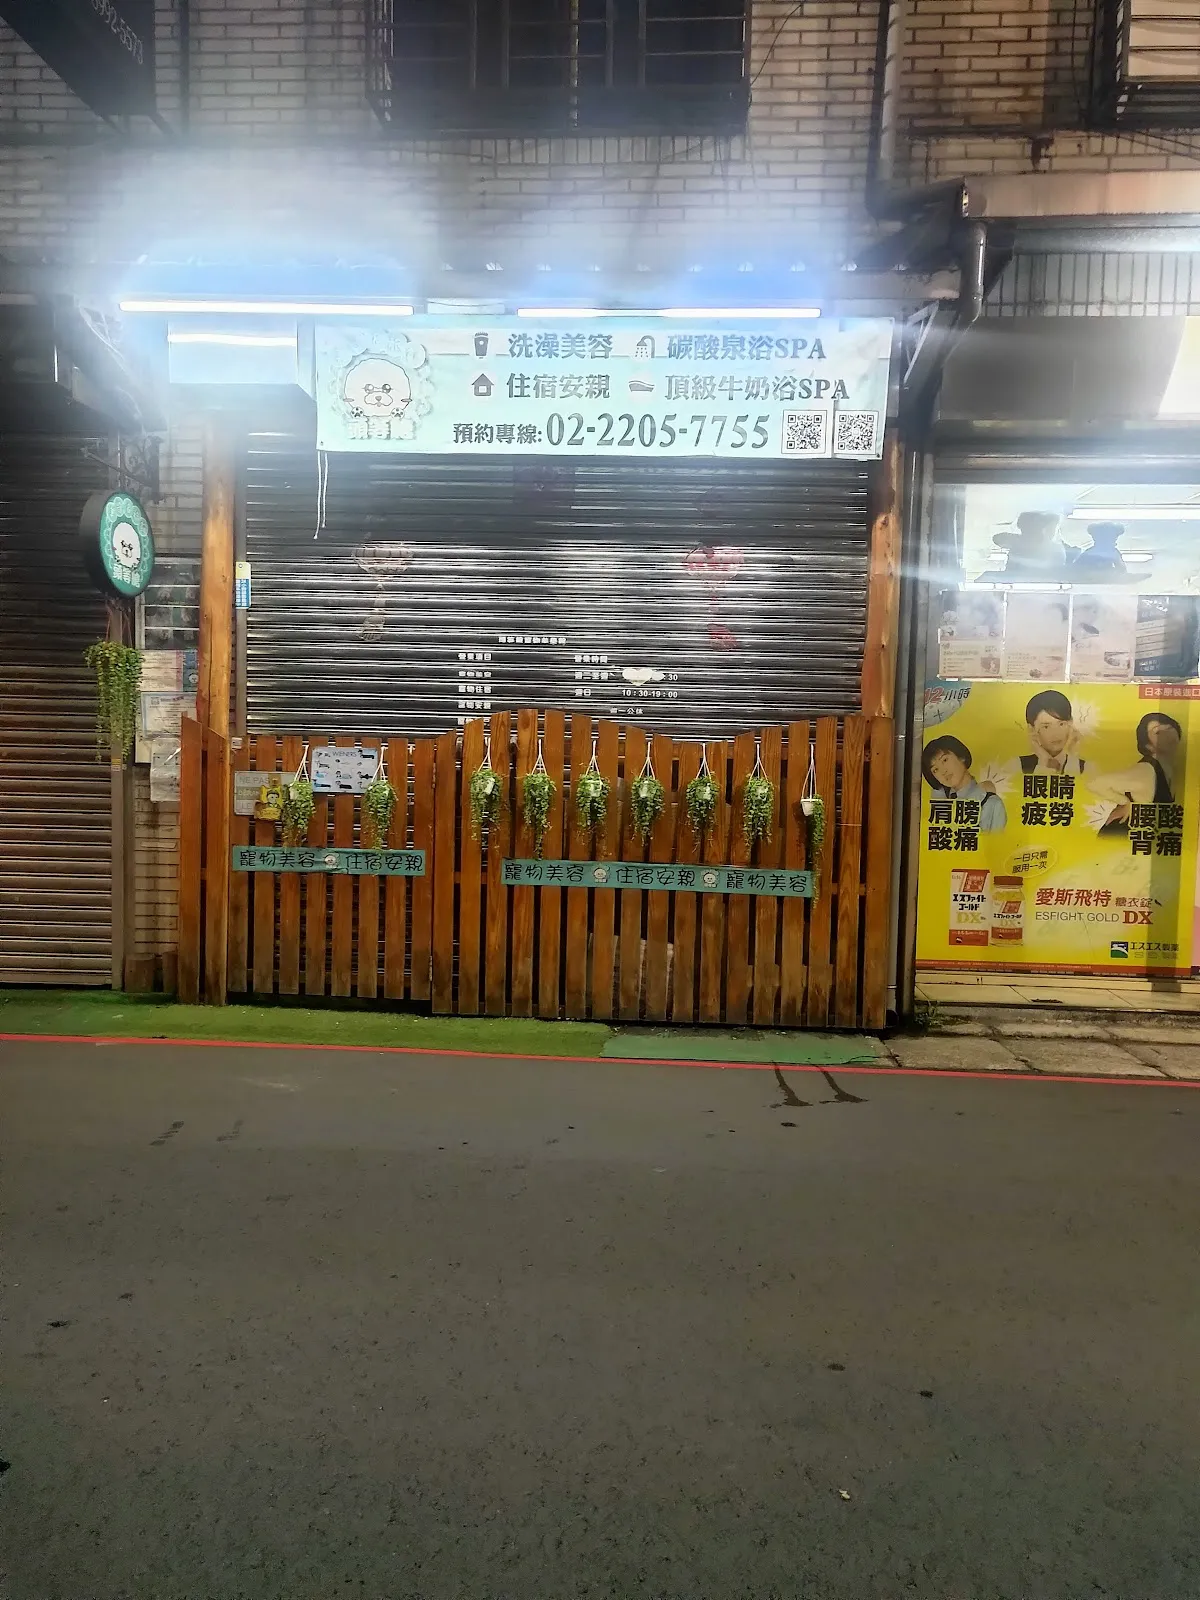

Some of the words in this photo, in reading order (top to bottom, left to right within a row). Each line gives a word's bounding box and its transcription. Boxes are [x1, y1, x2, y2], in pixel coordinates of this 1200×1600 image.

[508, 333, 613, 359] 洗澡美容
[667, 334, 826, 360] 碳酸泉浴SPA
[506, 373, 610, 399] 住宿安親
[664, 375, 850, 401] 頂級牛奶浴SPA
[547, 412, 770, 448] 02-2205-7755
[1023, 775, 1075, 800] 眼睛
[928, 799, 980, 826] 肩膀
[1021, 801, 1074, 827] 疲勞
[1130, 803, 1184, 829] 腰酸
[928, 826, 979, 852] 酸痛
[1129, 830, 1183, 856] 背痛
[239, 850, 316, 869] 寵物美容
[346, 854, 423, 872] 住宿安親
[504, 863, 585, 883] 寵物美容
[615, 866, 696, 887] 住宿安親
[725, 870, 808, 893] 寵物美容
[1035, 887, 1112, 908] 愛斯飛特
[1035, 911, 1083, 921] ESFIGHT
[1087, 912, 1120, 923] GOLD
[1122, 910, 1154, 925] DX
